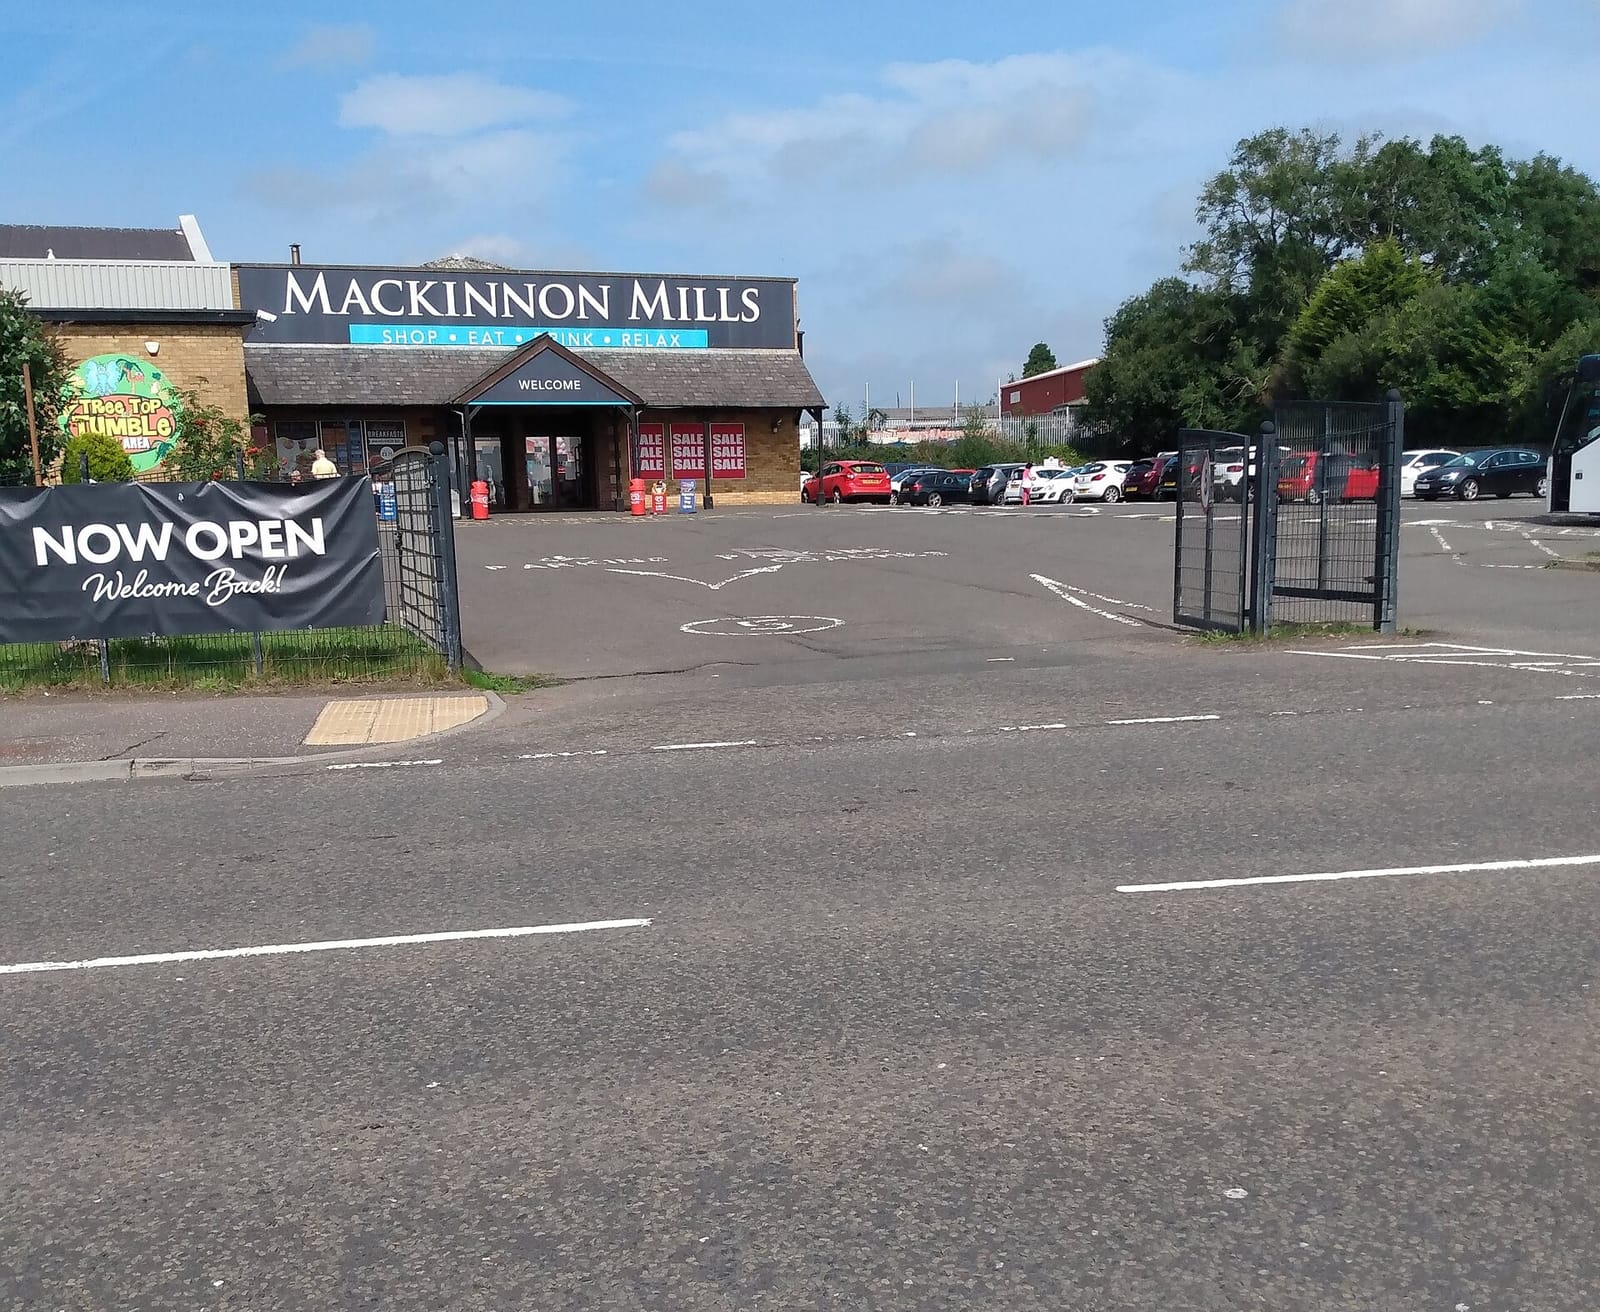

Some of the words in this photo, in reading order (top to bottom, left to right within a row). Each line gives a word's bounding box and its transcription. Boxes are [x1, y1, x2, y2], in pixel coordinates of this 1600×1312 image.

[281, 271, 611, 321] MACKINNON
[629, 280, 761, 323] MILLS
[382, 329, 438, 344] SHOP
[468, 332, 505, 345] EAT
[621, 334, 681, 348] RELAX
[518, 379, 582, 391] WELCOME
[367, 430, 404, 438] BREAKFASTS
[640, 434, 662, 445] ALE
[672, 434, 704, 445] SALE
[712, 434, 743, 445] SALE
[123, 437, 151, 450] AREA
[640, 447, 663, 458] ALE
[673, 446, 705, 457] SALE
[712, 446, 744, 457] SALE
[640, 460, 664, 471] ALE
[673, 459, 705, 470] SALE
[713, 459, 744, 470] SALE
[32, 523, 174, 566] NOW
[186, 518, 326, 560] OPEN
[82, 569, 200, 603] Welcome
[205, 564, 284, 605] Back!
